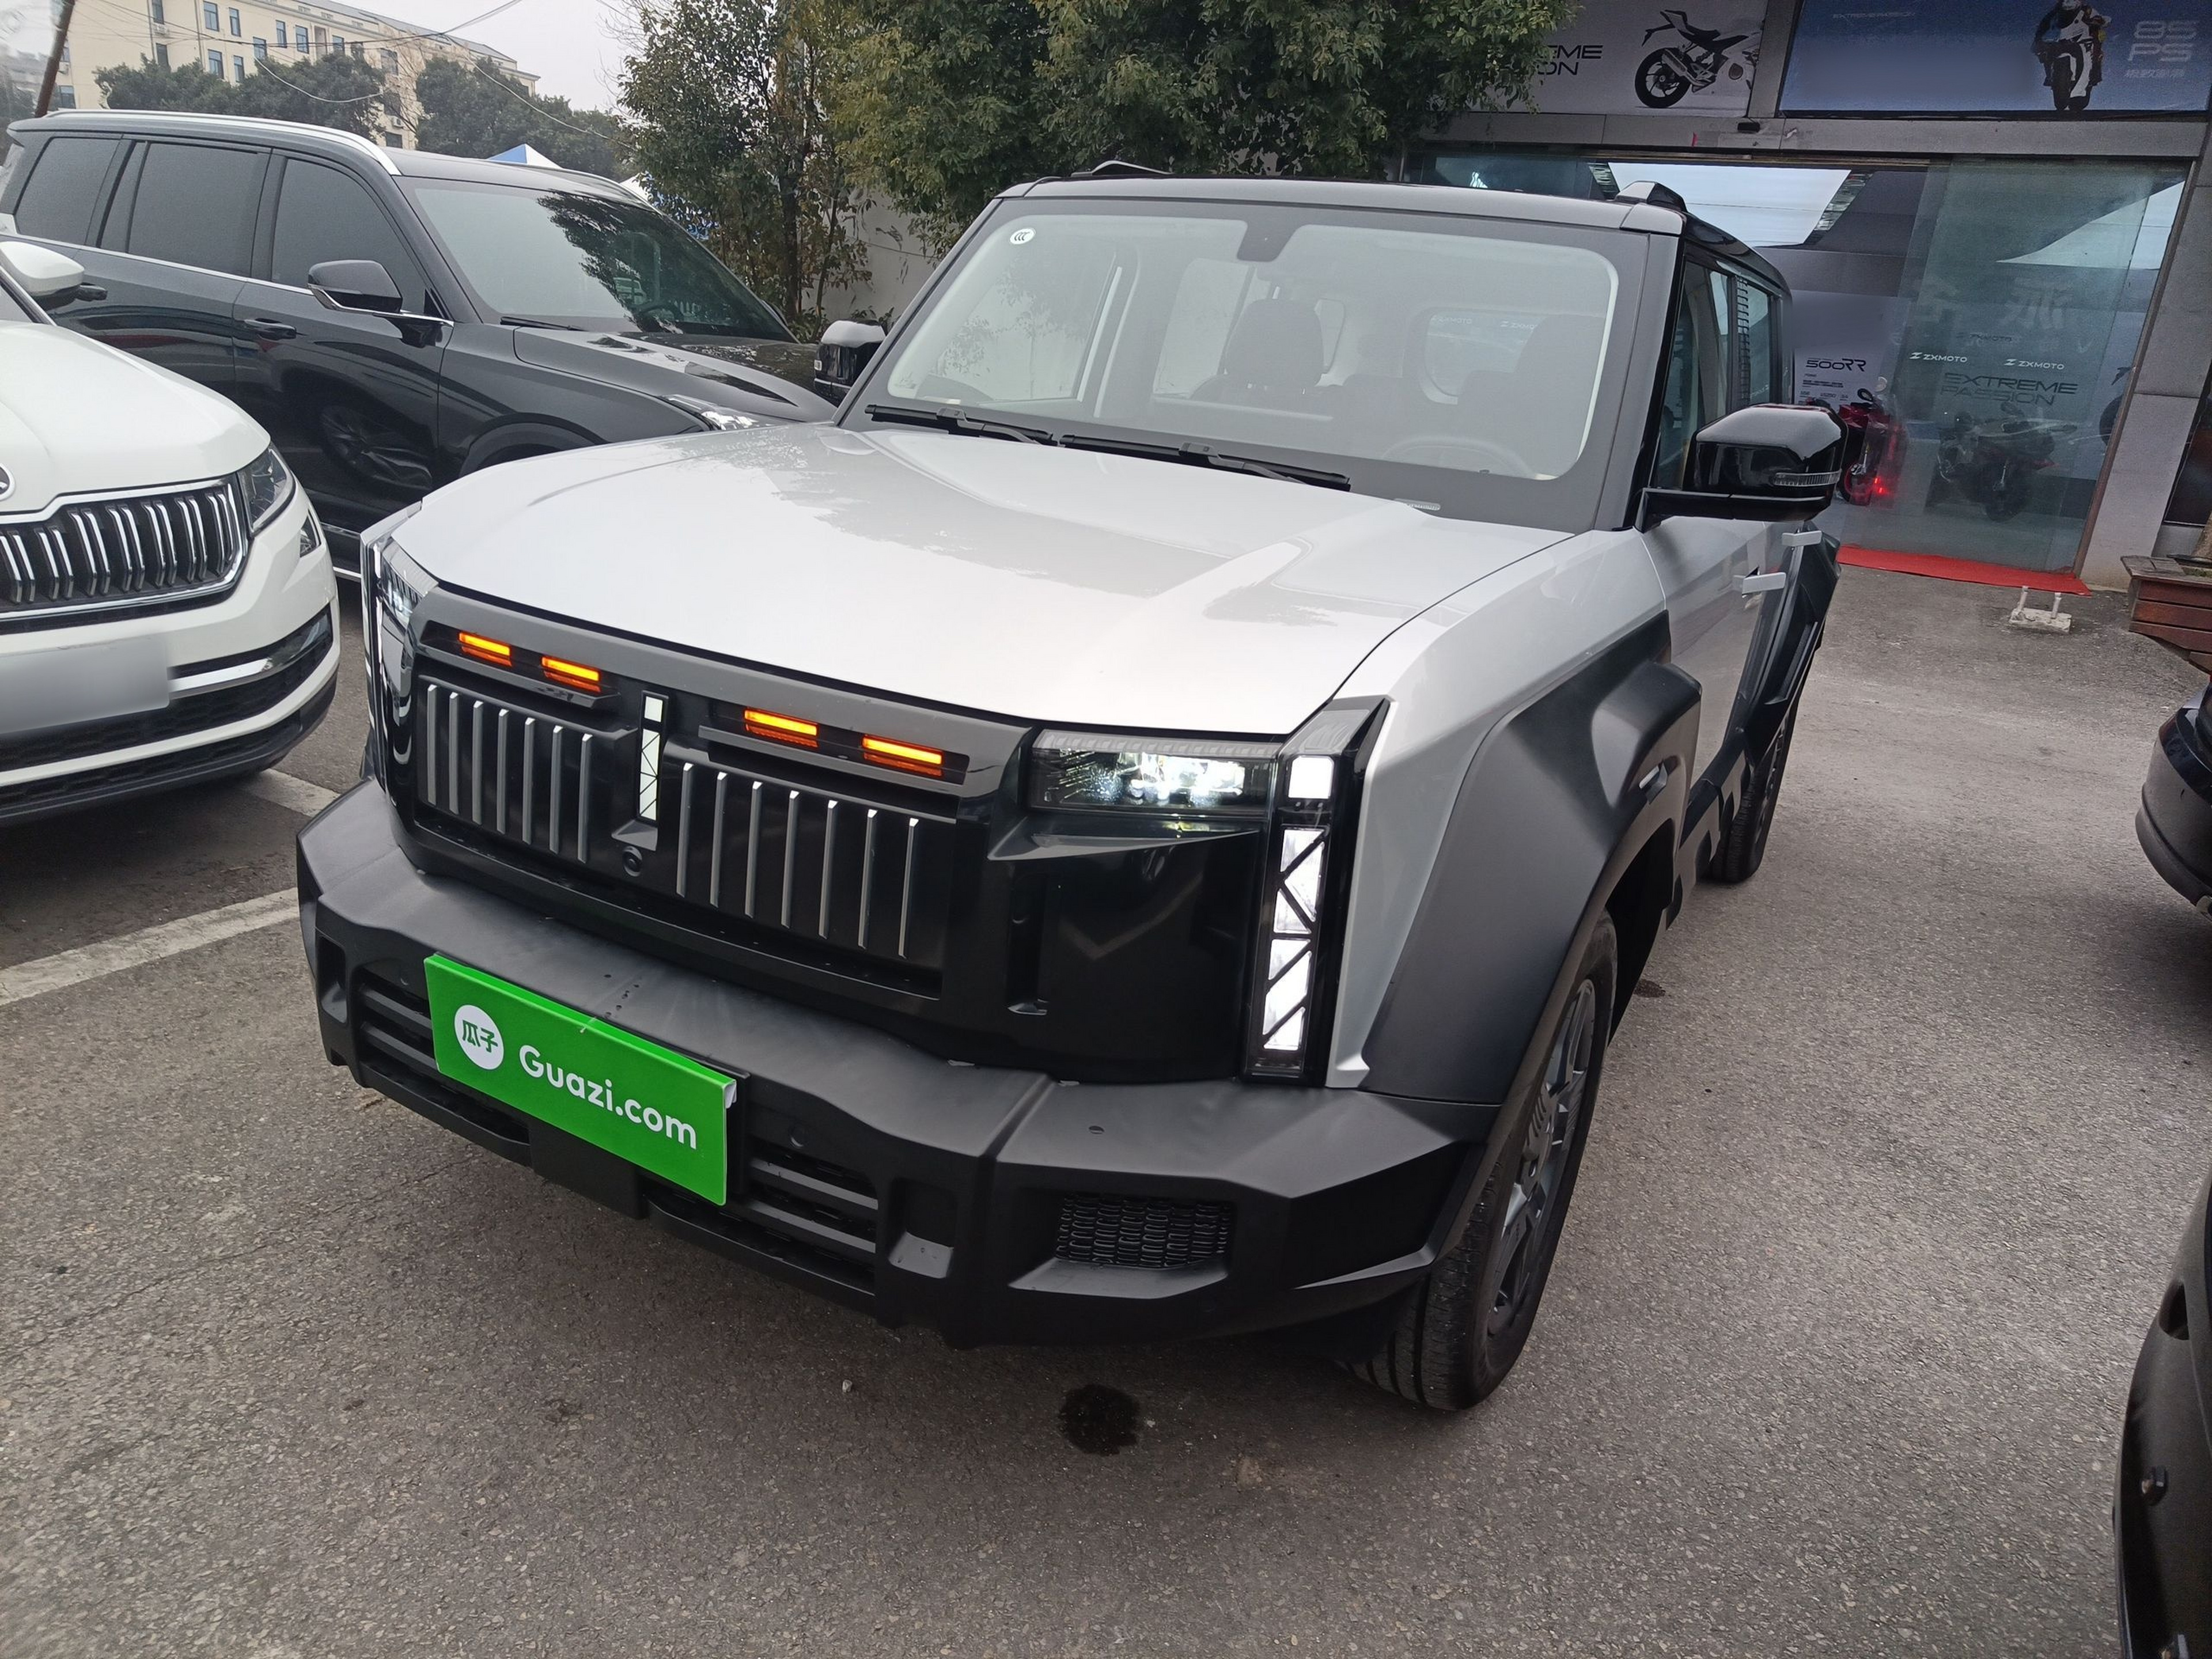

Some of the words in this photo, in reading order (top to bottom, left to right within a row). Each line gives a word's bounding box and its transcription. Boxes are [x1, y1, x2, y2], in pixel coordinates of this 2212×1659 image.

[2127, 43, 2194, 62] PS
[1805, 358, 1867, 372] 500RR
[1923, 353, 1968, 363] ZXMOTO
[2017, 360, 2065, 370] ZXMOTO
[1944, 372, 2079, 395] EXTREME
[1940, 385, 2056, 406] PASSION
[463, 1018, 499, 1054] 瓜子
[518, 1044, 698, 1151] Guazi.com
